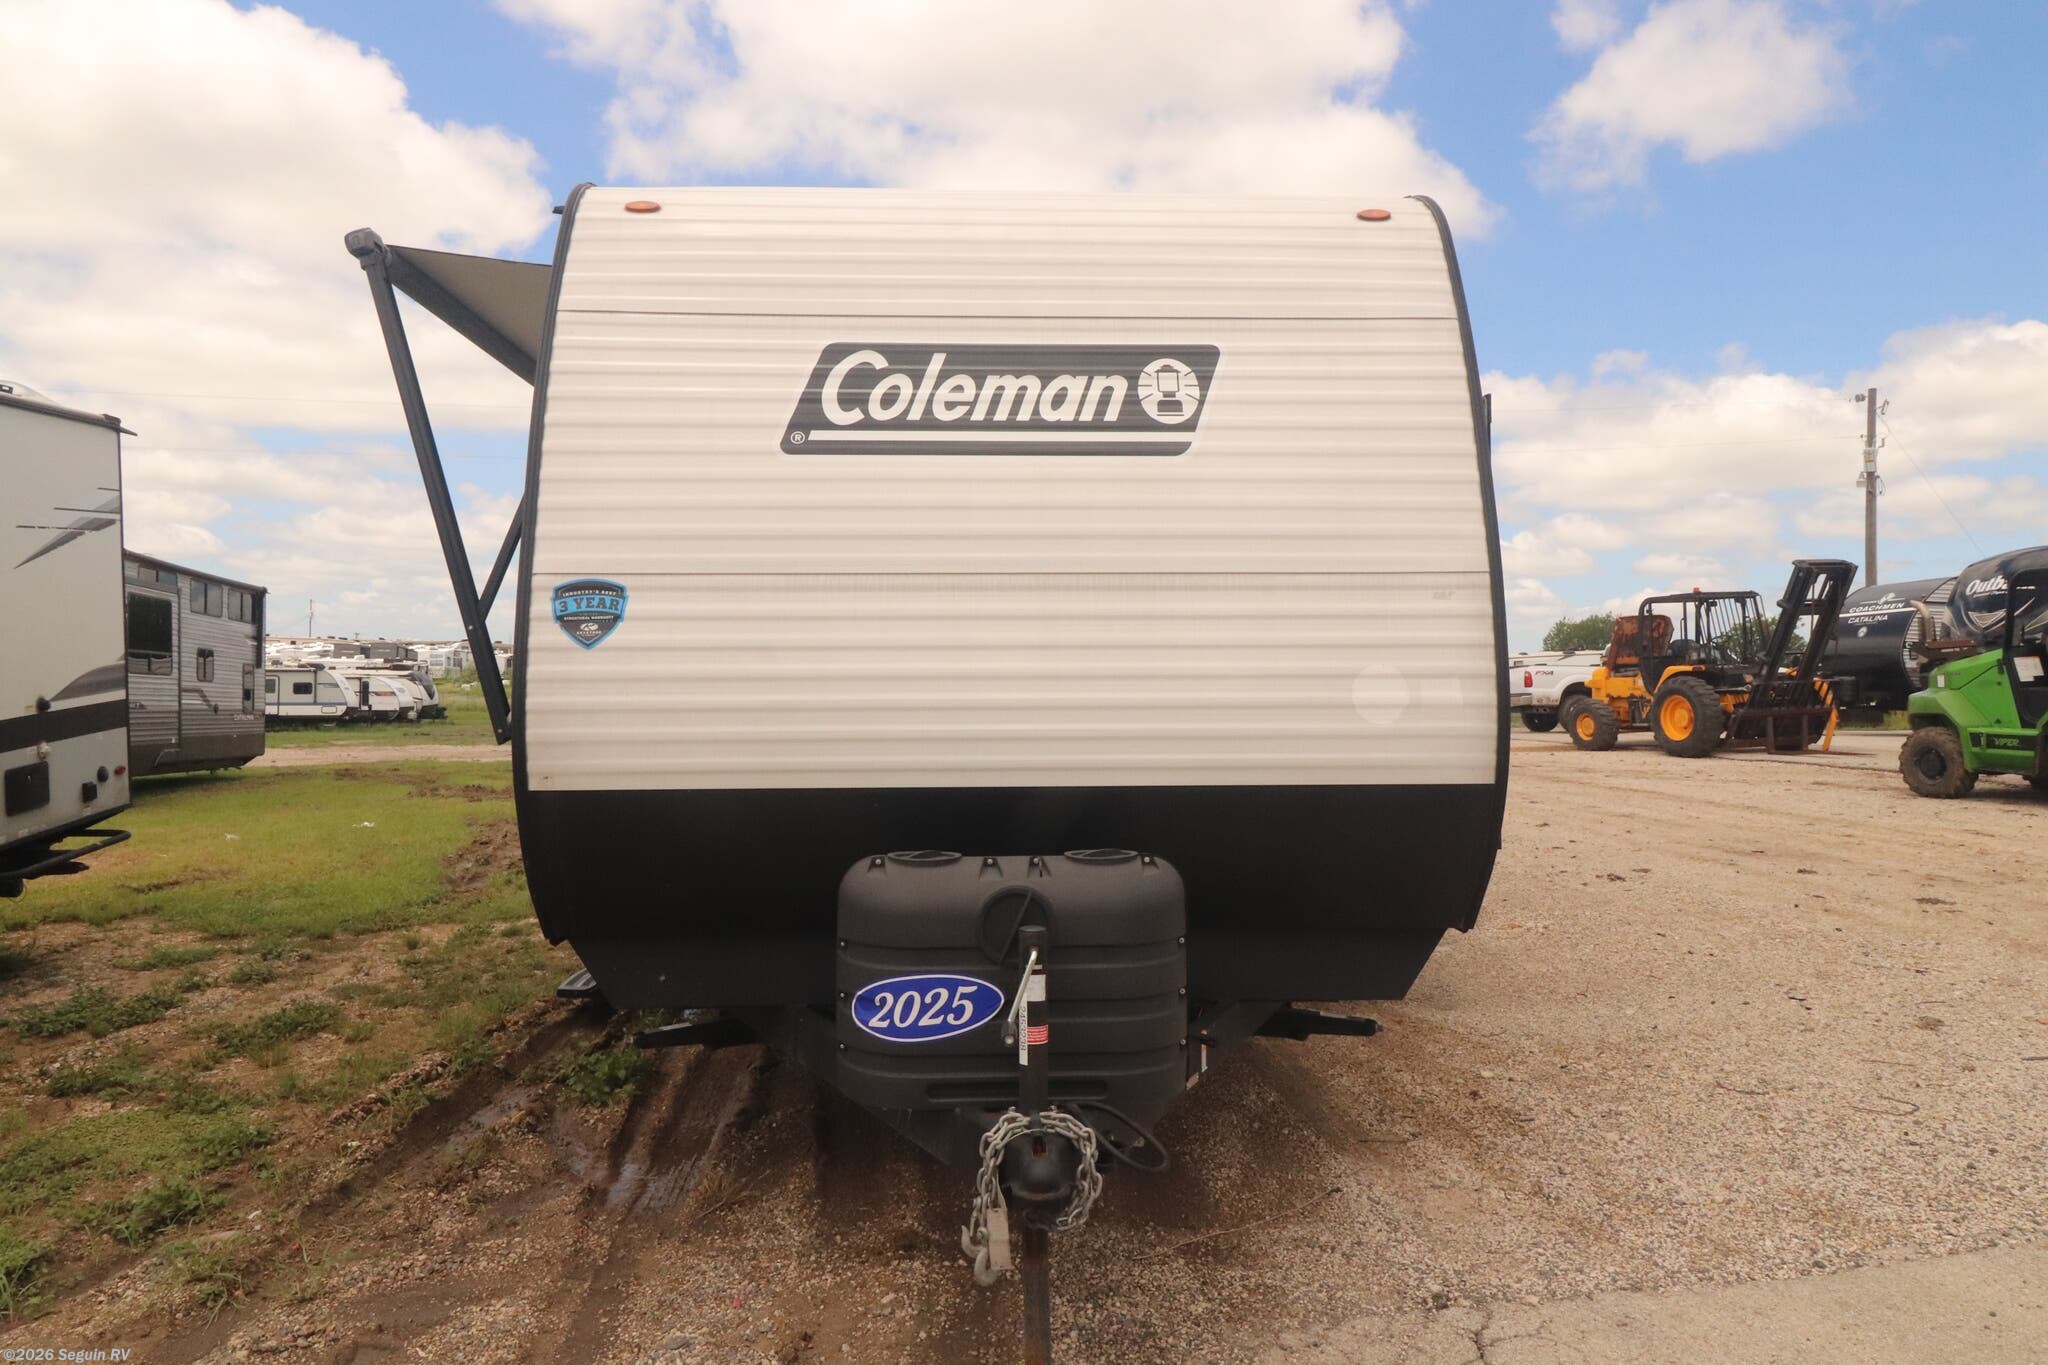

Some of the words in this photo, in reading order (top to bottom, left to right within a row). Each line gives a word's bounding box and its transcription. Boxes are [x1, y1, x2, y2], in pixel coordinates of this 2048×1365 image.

[821, 349, 1129, 426] Coleman
[559, 601, 568, 612] 3
[573, 597, 619, 611] YEAR
[1848, 602, 1905, 613] COACHMEN
[1847, 614, 1888, 624] CATALINA
[868, 985, 978, 1028] 2025
